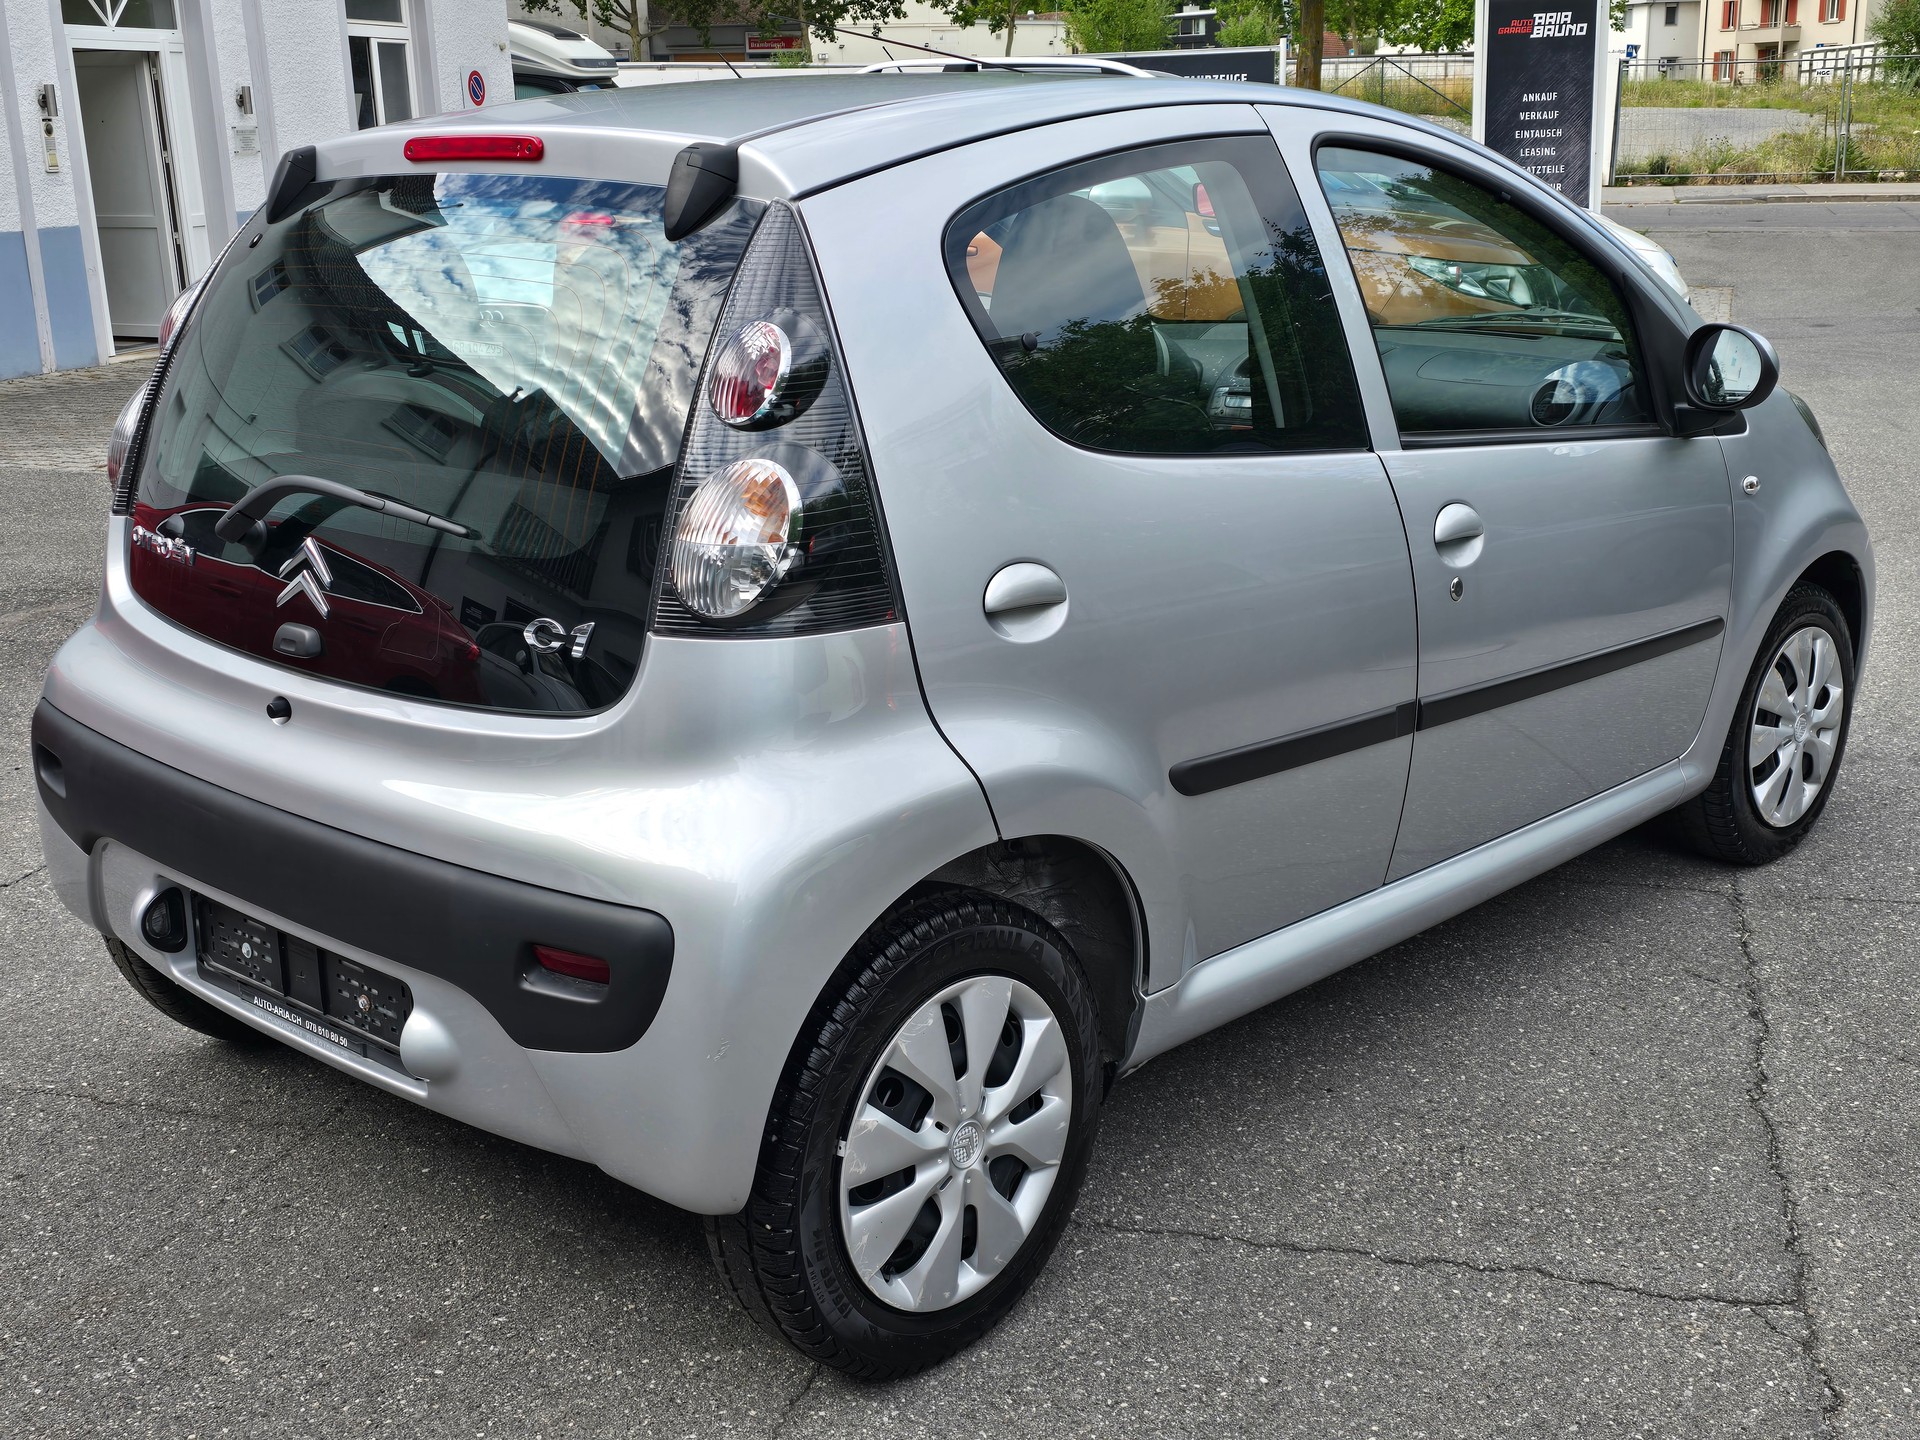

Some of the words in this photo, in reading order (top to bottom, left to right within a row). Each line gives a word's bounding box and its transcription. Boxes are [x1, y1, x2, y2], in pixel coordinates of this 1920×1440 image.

[1511, 19, 1534, 27] AUTO
[1498, 26, 1533, 35] GARAGE
[1522, 92, 1558, 102] ANKAUF
[1519, 110, 1560, 121] VERKAUF
[1515, 128, 1563, 139] EINTAUSCH
[1520, 147, 1556, 157] LEASING
[523, 617, 596, 659] C1
[253, 996, 302, 1026] AUTO-ARIA.CH
